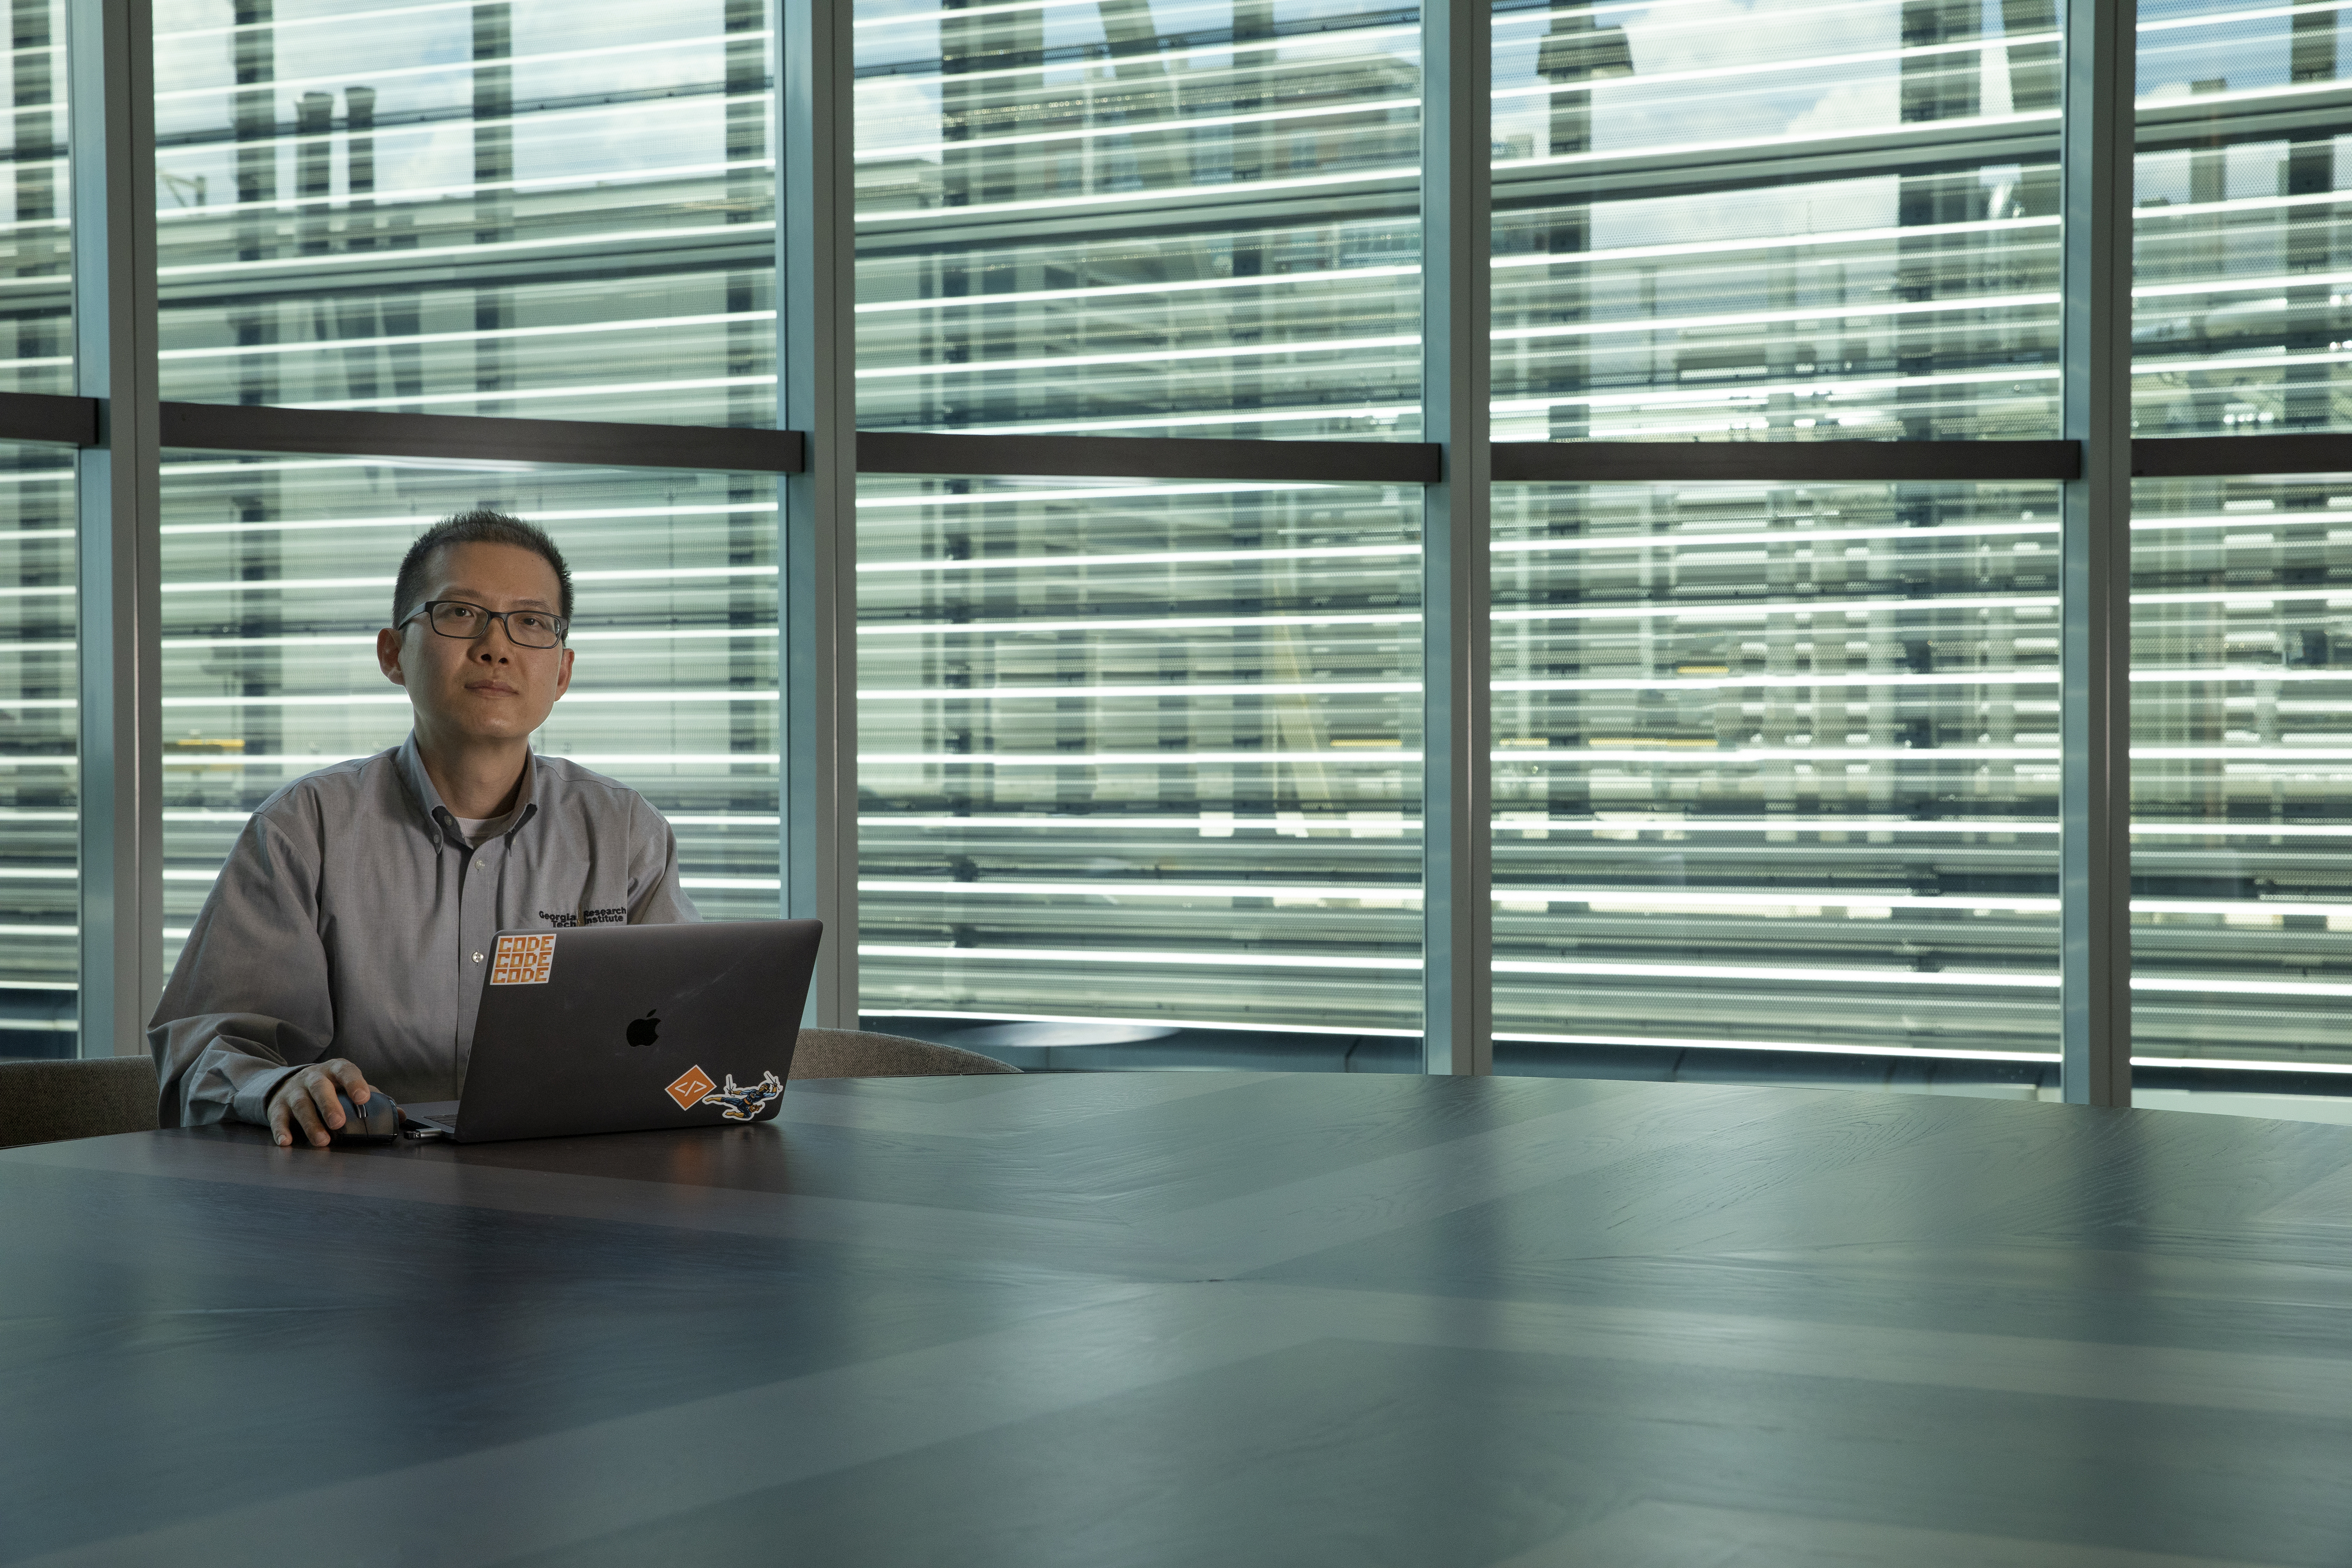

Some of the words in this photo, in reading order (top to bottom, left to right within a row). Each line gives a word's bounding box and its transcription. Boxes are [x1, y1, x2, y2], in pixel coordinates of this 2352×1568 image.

[539, 911, 576, 923] Georgia
[584, 907, 626, 917] Research
[584, 914, 624, 925] Institute
[498, 935, 554, 953] CODE
[495, 952, 552, 968] CODE
[492, 967, 549, 983] CODE
